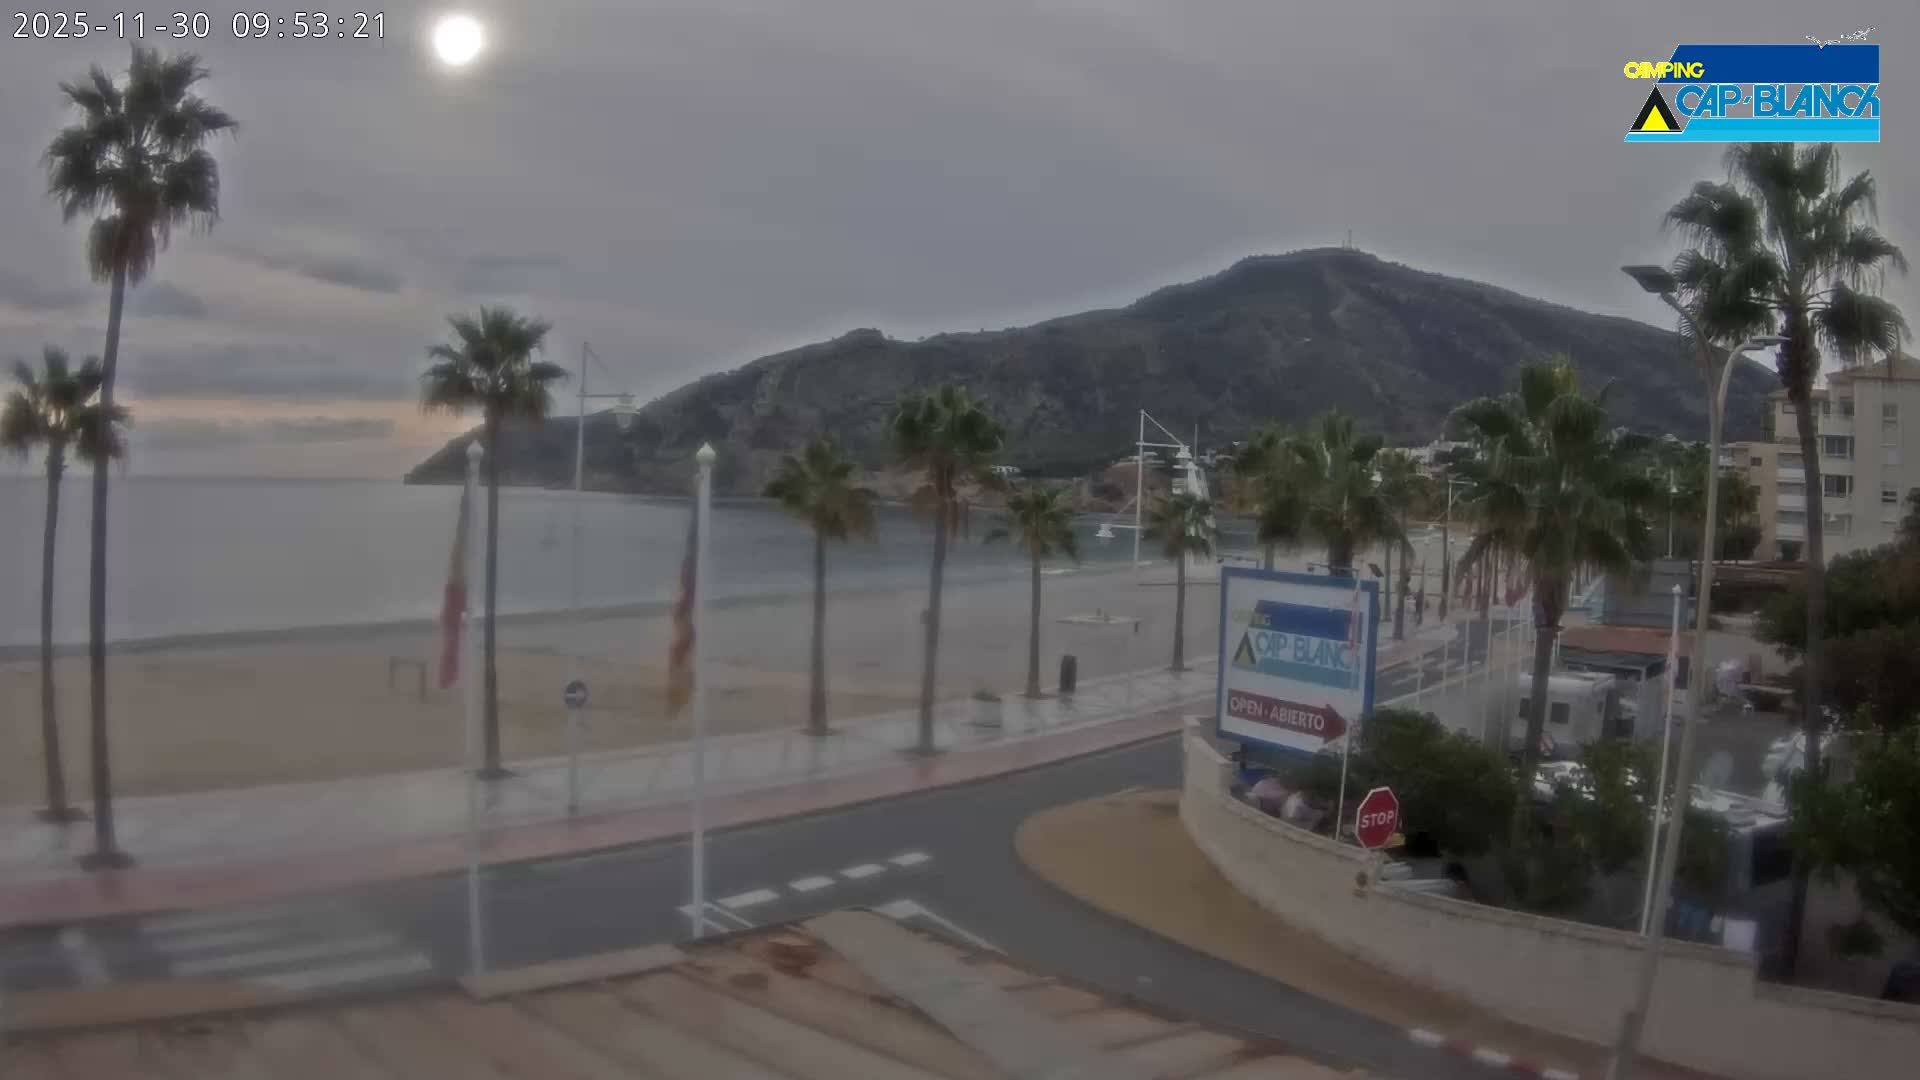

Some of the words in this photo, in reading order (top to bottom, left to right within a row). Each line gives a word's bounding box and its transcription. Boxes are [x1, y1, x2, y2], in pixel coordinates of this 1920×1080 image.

[1231, 696, 1263, 717] OPEN
[1270, 705, 1325, 731] ABIERTO
[1361, 810, 1394, 828] STOP
